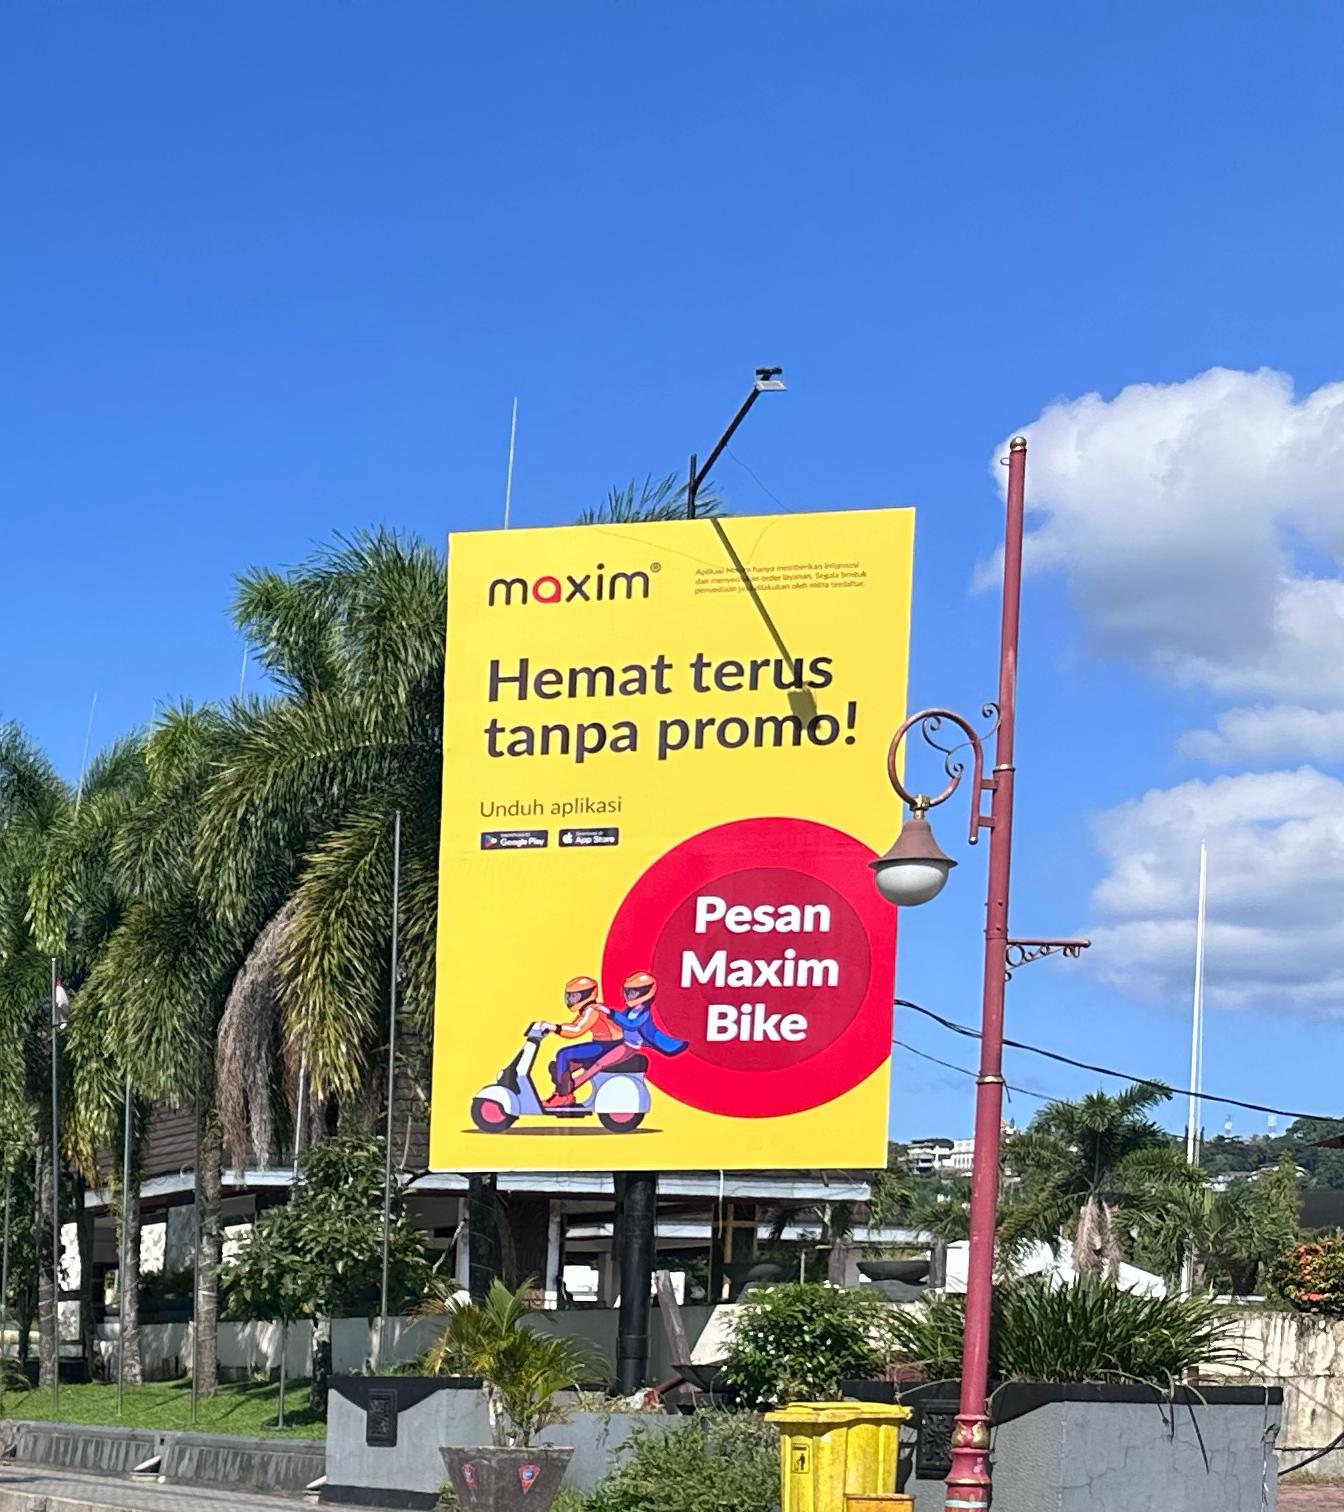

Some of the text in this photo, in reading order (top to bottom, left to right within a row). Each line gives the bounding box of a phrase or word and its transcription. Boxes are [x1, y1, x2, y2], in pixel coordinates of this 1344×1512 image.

[488, 654, 833, 702] Hemat terus
[484, 701, 858, 763] tanpa promo!
[480, 797, 622, 817] Unduh aplikasi
[500, 836, 545, 847] Google Play
[575, 834, 615, 845] App Store
[694, 897, 830, 934] Pesan
[680, 949, 838, 989] Maxim
[706, 1003, 808, 1041] Bike
